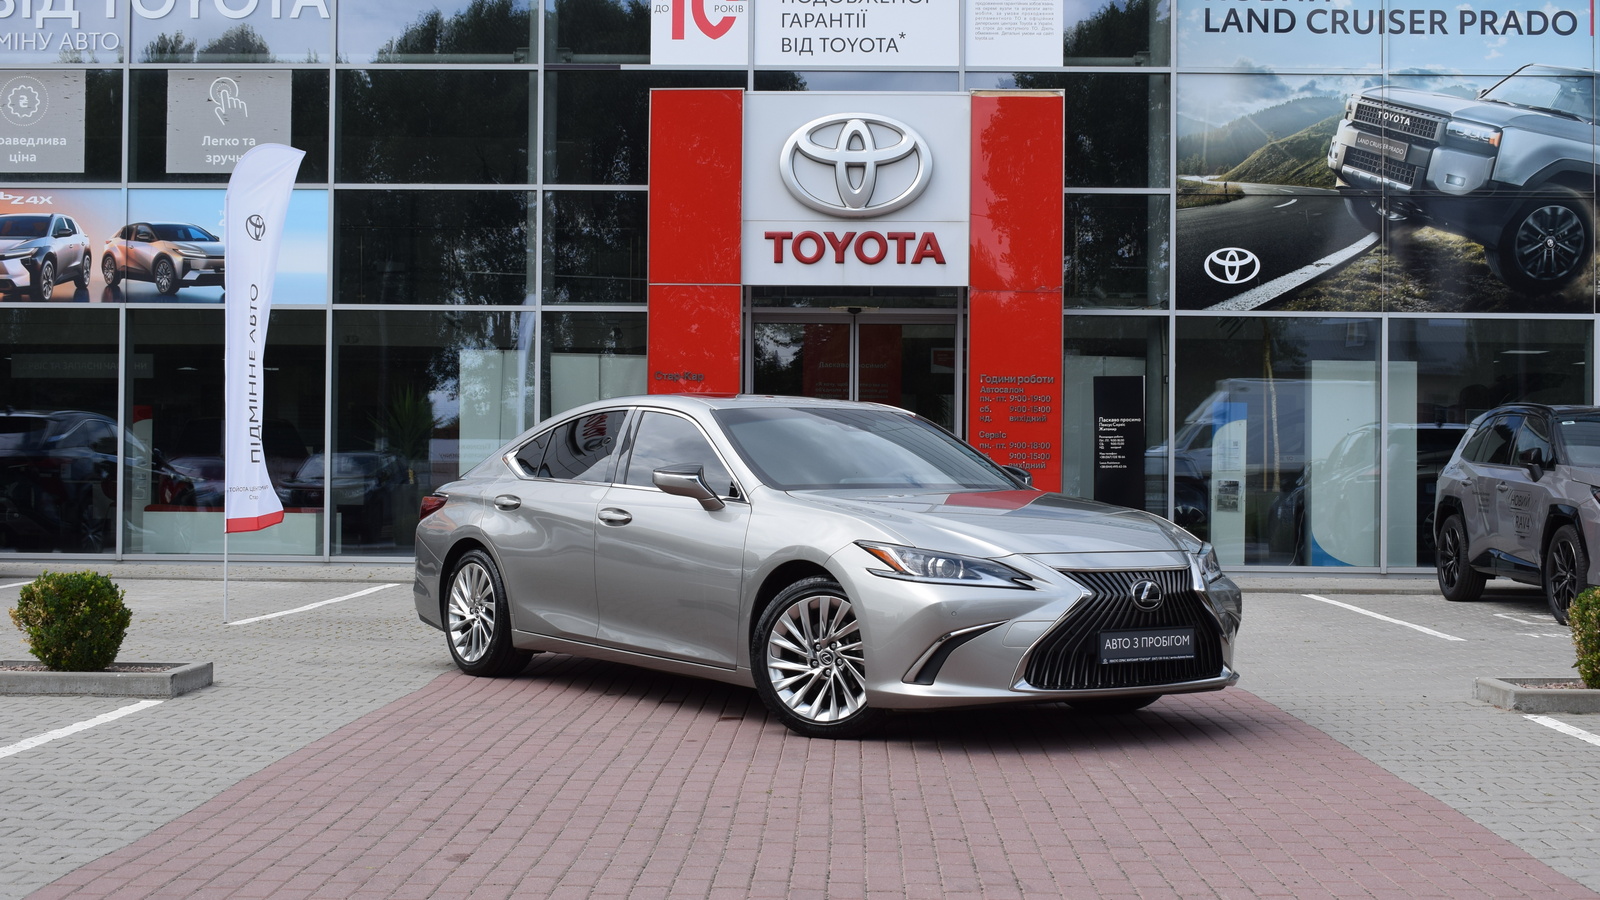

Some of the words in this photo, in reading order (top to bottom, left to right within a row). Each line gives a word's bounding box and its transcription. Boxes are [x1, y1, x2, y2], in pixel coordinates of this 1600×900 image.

[655, 5, 669, 13] ДО
[782, 9, 868, 28] ГАРАНТІЇ
[1205, 8, 1296, 33] LAND
[1306, 9, 1448, 34] CRUISER
[1459, 10, 1577, 36] PRADO
[59, 32, 119, 50] АВТО
[782, 38, 813, 56] ВІД
[1378, 111, 1410, 125] TOYOTA
[202, 136, 239, 146] Легко
[10, 151, 36, 163] ціна
[206, 155, 243, 165] зручн
[765, 231, 946, 264] TOYOTA
[249, 284, 258, 342] АВТО
[655, 371, 704, 382] Стар-Кар
[980, 374, 1016, 383] Години
[1018, 375, 1054, 385] роботи
[249, 350, 261, 463] ПІДМІННЕ
[979, 430, 1006, 440] Сервіс
[1511, 494, 1530, 507] НОВИЙ
[1516, 515, 1530, 530] RAV4
[1105, 638, 1130, 649] АВТО
[1141, 635, 1190, 647] ПРОБІГОМ
